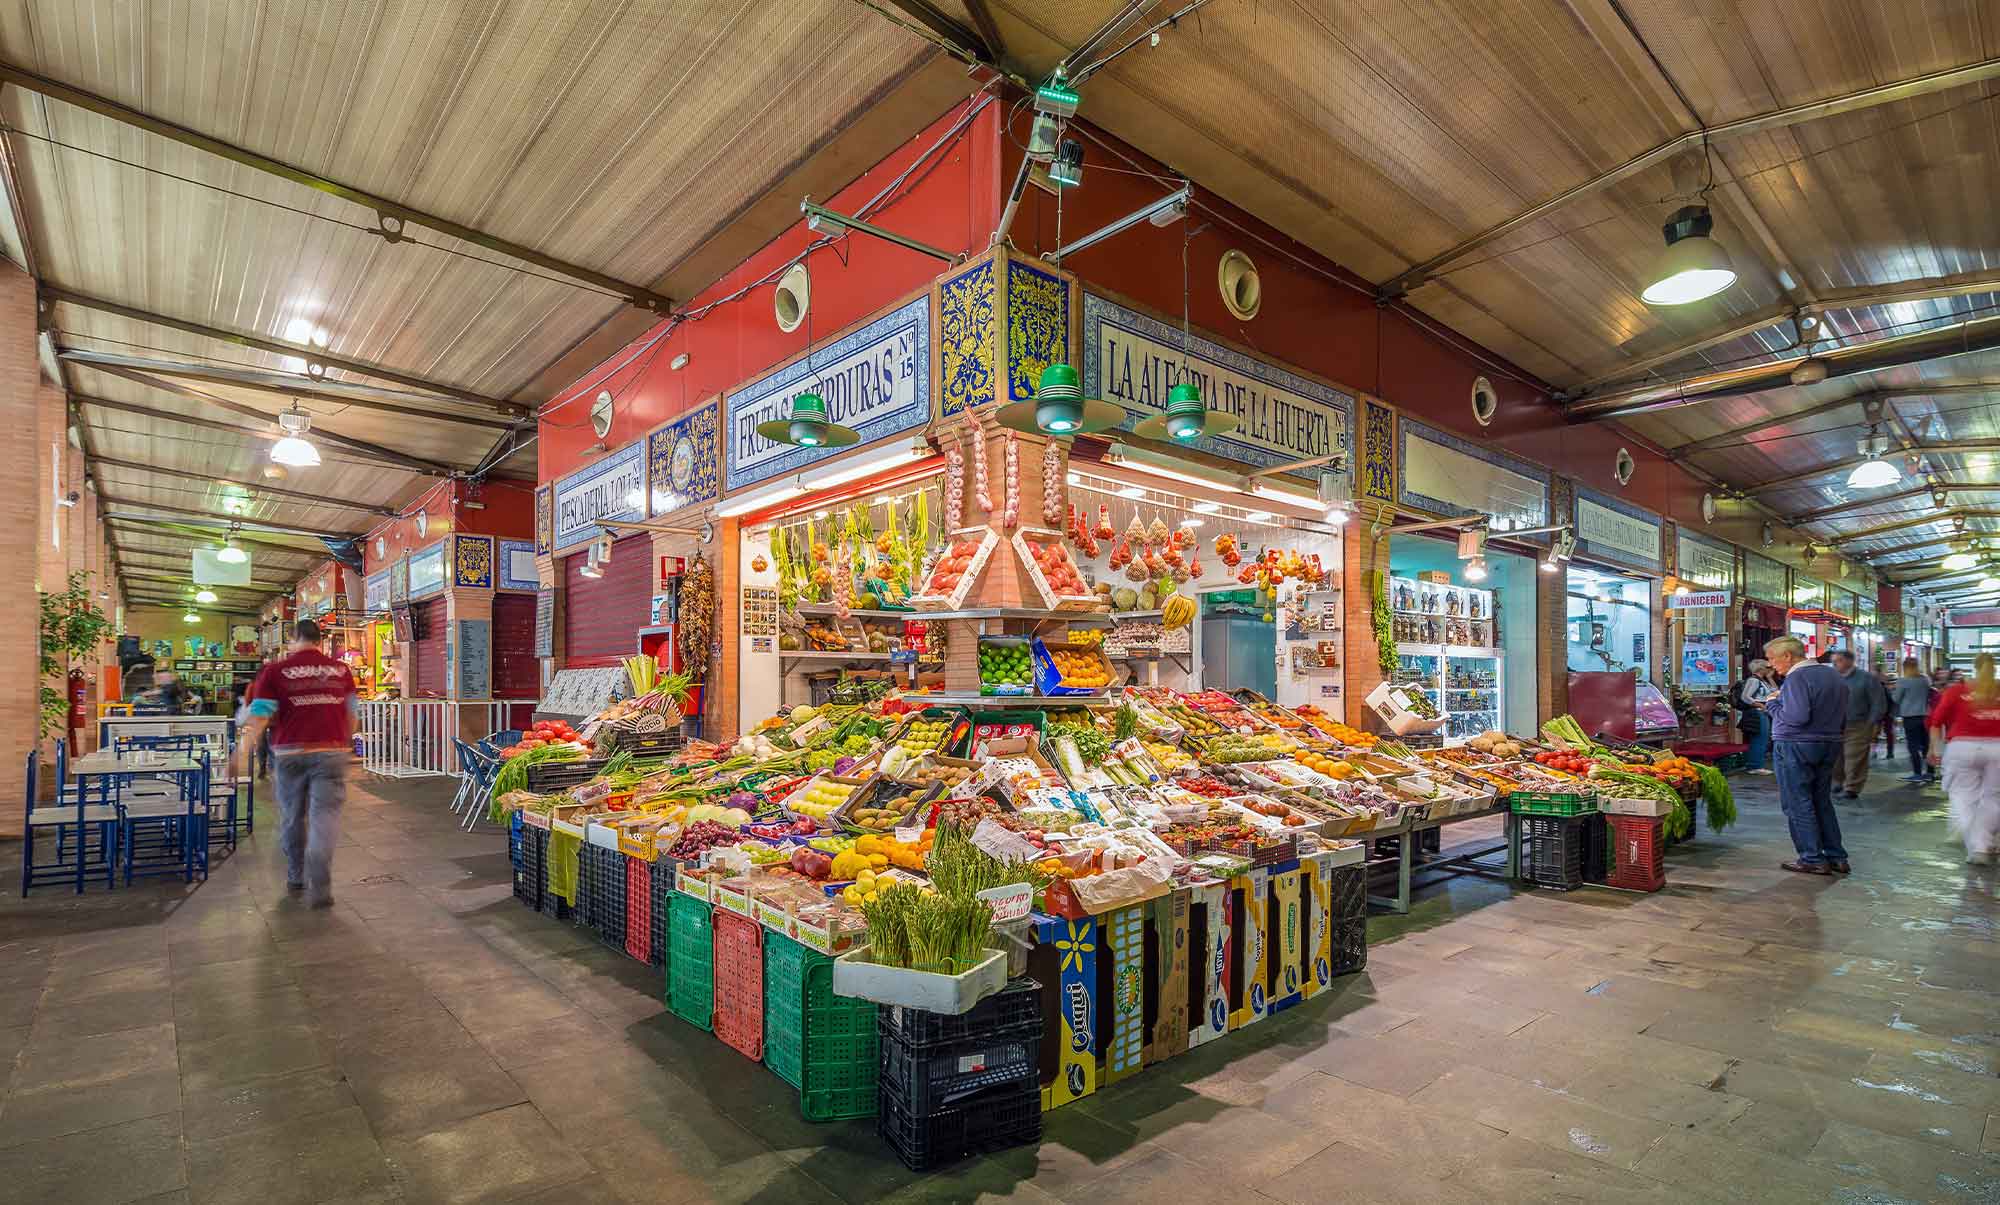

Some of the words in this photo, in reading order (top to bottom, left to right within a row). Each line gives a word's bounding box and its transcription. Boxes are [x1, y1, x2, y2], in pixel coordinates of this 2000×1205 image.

[900, 356, 914, 380] 15
[1108, 339, 1135, 402] LA
[1224, 381, 1247, 439] DE
[1251, 391, 1271, 442] LA
[1273, 398, 1330, 456] HUERTA
